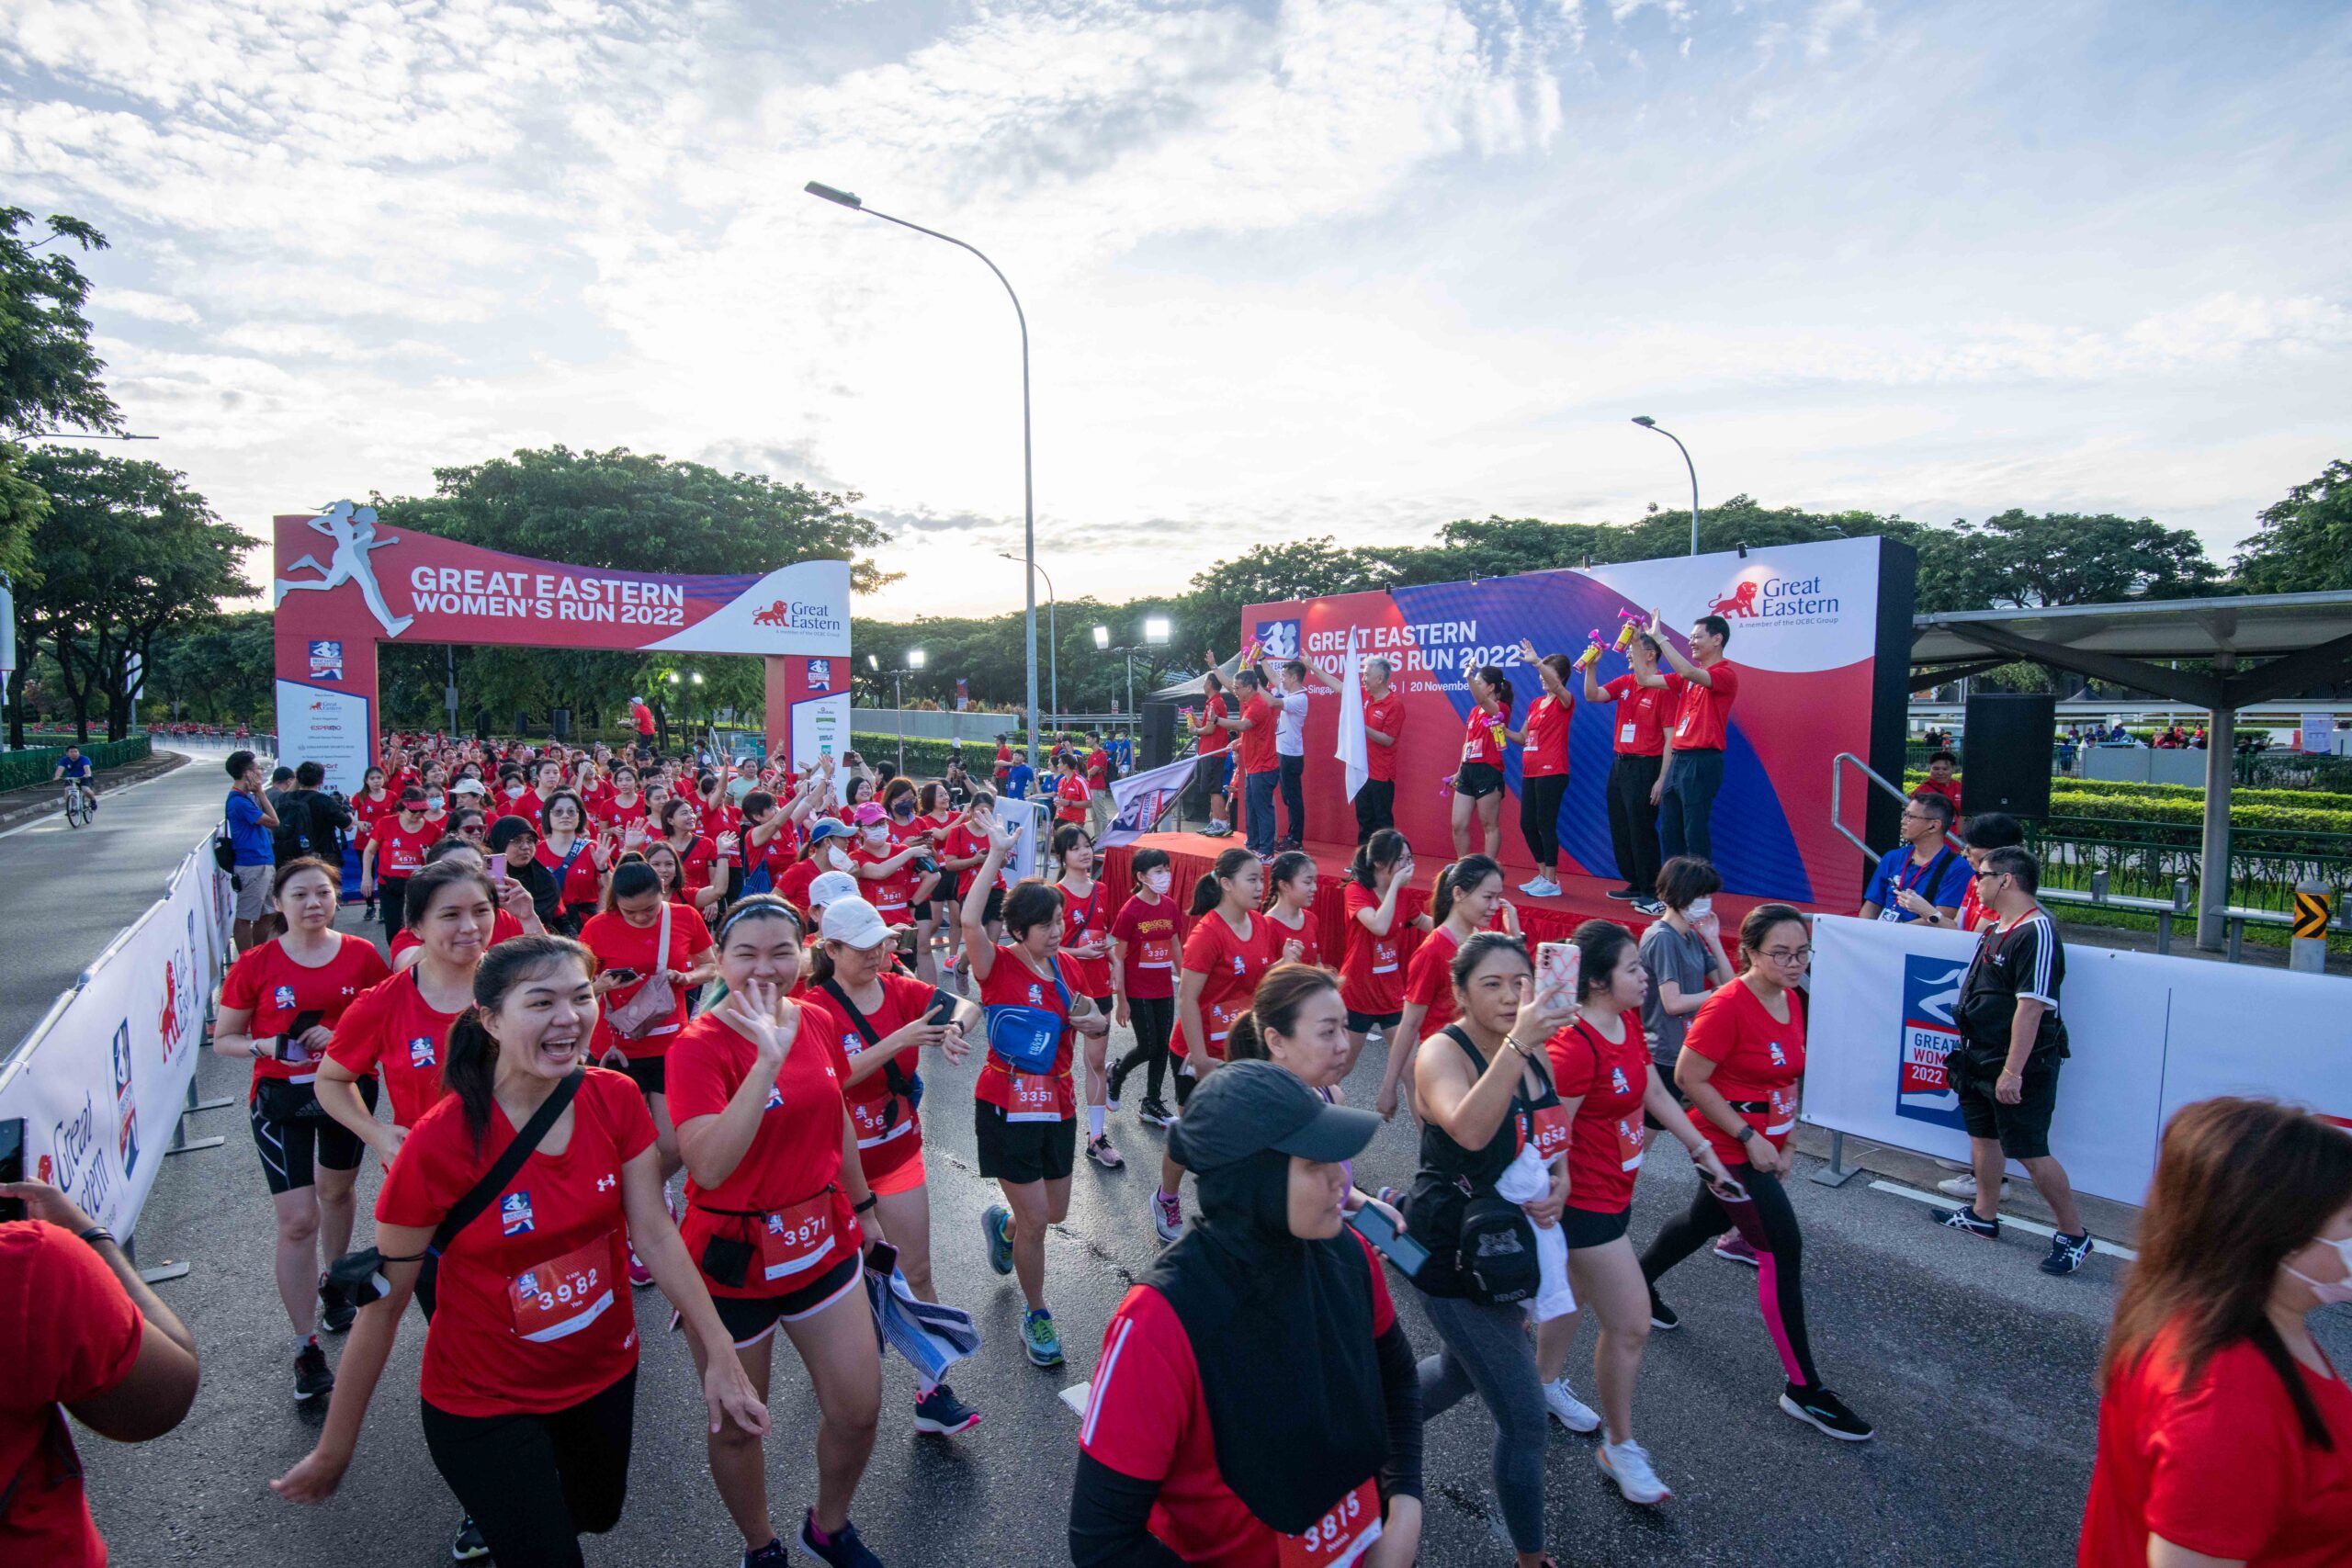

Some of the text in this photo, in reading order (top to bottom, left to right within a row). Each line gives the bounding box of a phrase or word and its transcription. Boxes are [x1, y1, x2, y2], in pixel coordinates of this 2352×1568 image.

[411, 566, 684, 607] GREAT EASTERN
[1763, 576, 1821, 597] Great
[412, 592, 684, 626] WOMEN'S RUN 2022
[791, 602, 829, 616] Great
[1762, 597, 1839, 617] Eastern
[791, 615, 840, 630] Eastern
[1377, 620, 1476, 649] EASTERN
[1408, 648, 1453, 671] RUN
[1459, 645, 1521, 671] 2022
[1410, 682, 1423, 692] 20
[1425, 681, 1470, 692] Novembe
[1911, 1065, 1943, 1085] 2022
[1020, 1091, 1052, 1101] 3351
[1533, 1126, 1566, 1147] 4652
[784, 1215, 826, 1247] 3971
[537, 1268, 597, 1311] 3982
[1304, 1490, 1360, 1552] 3815
